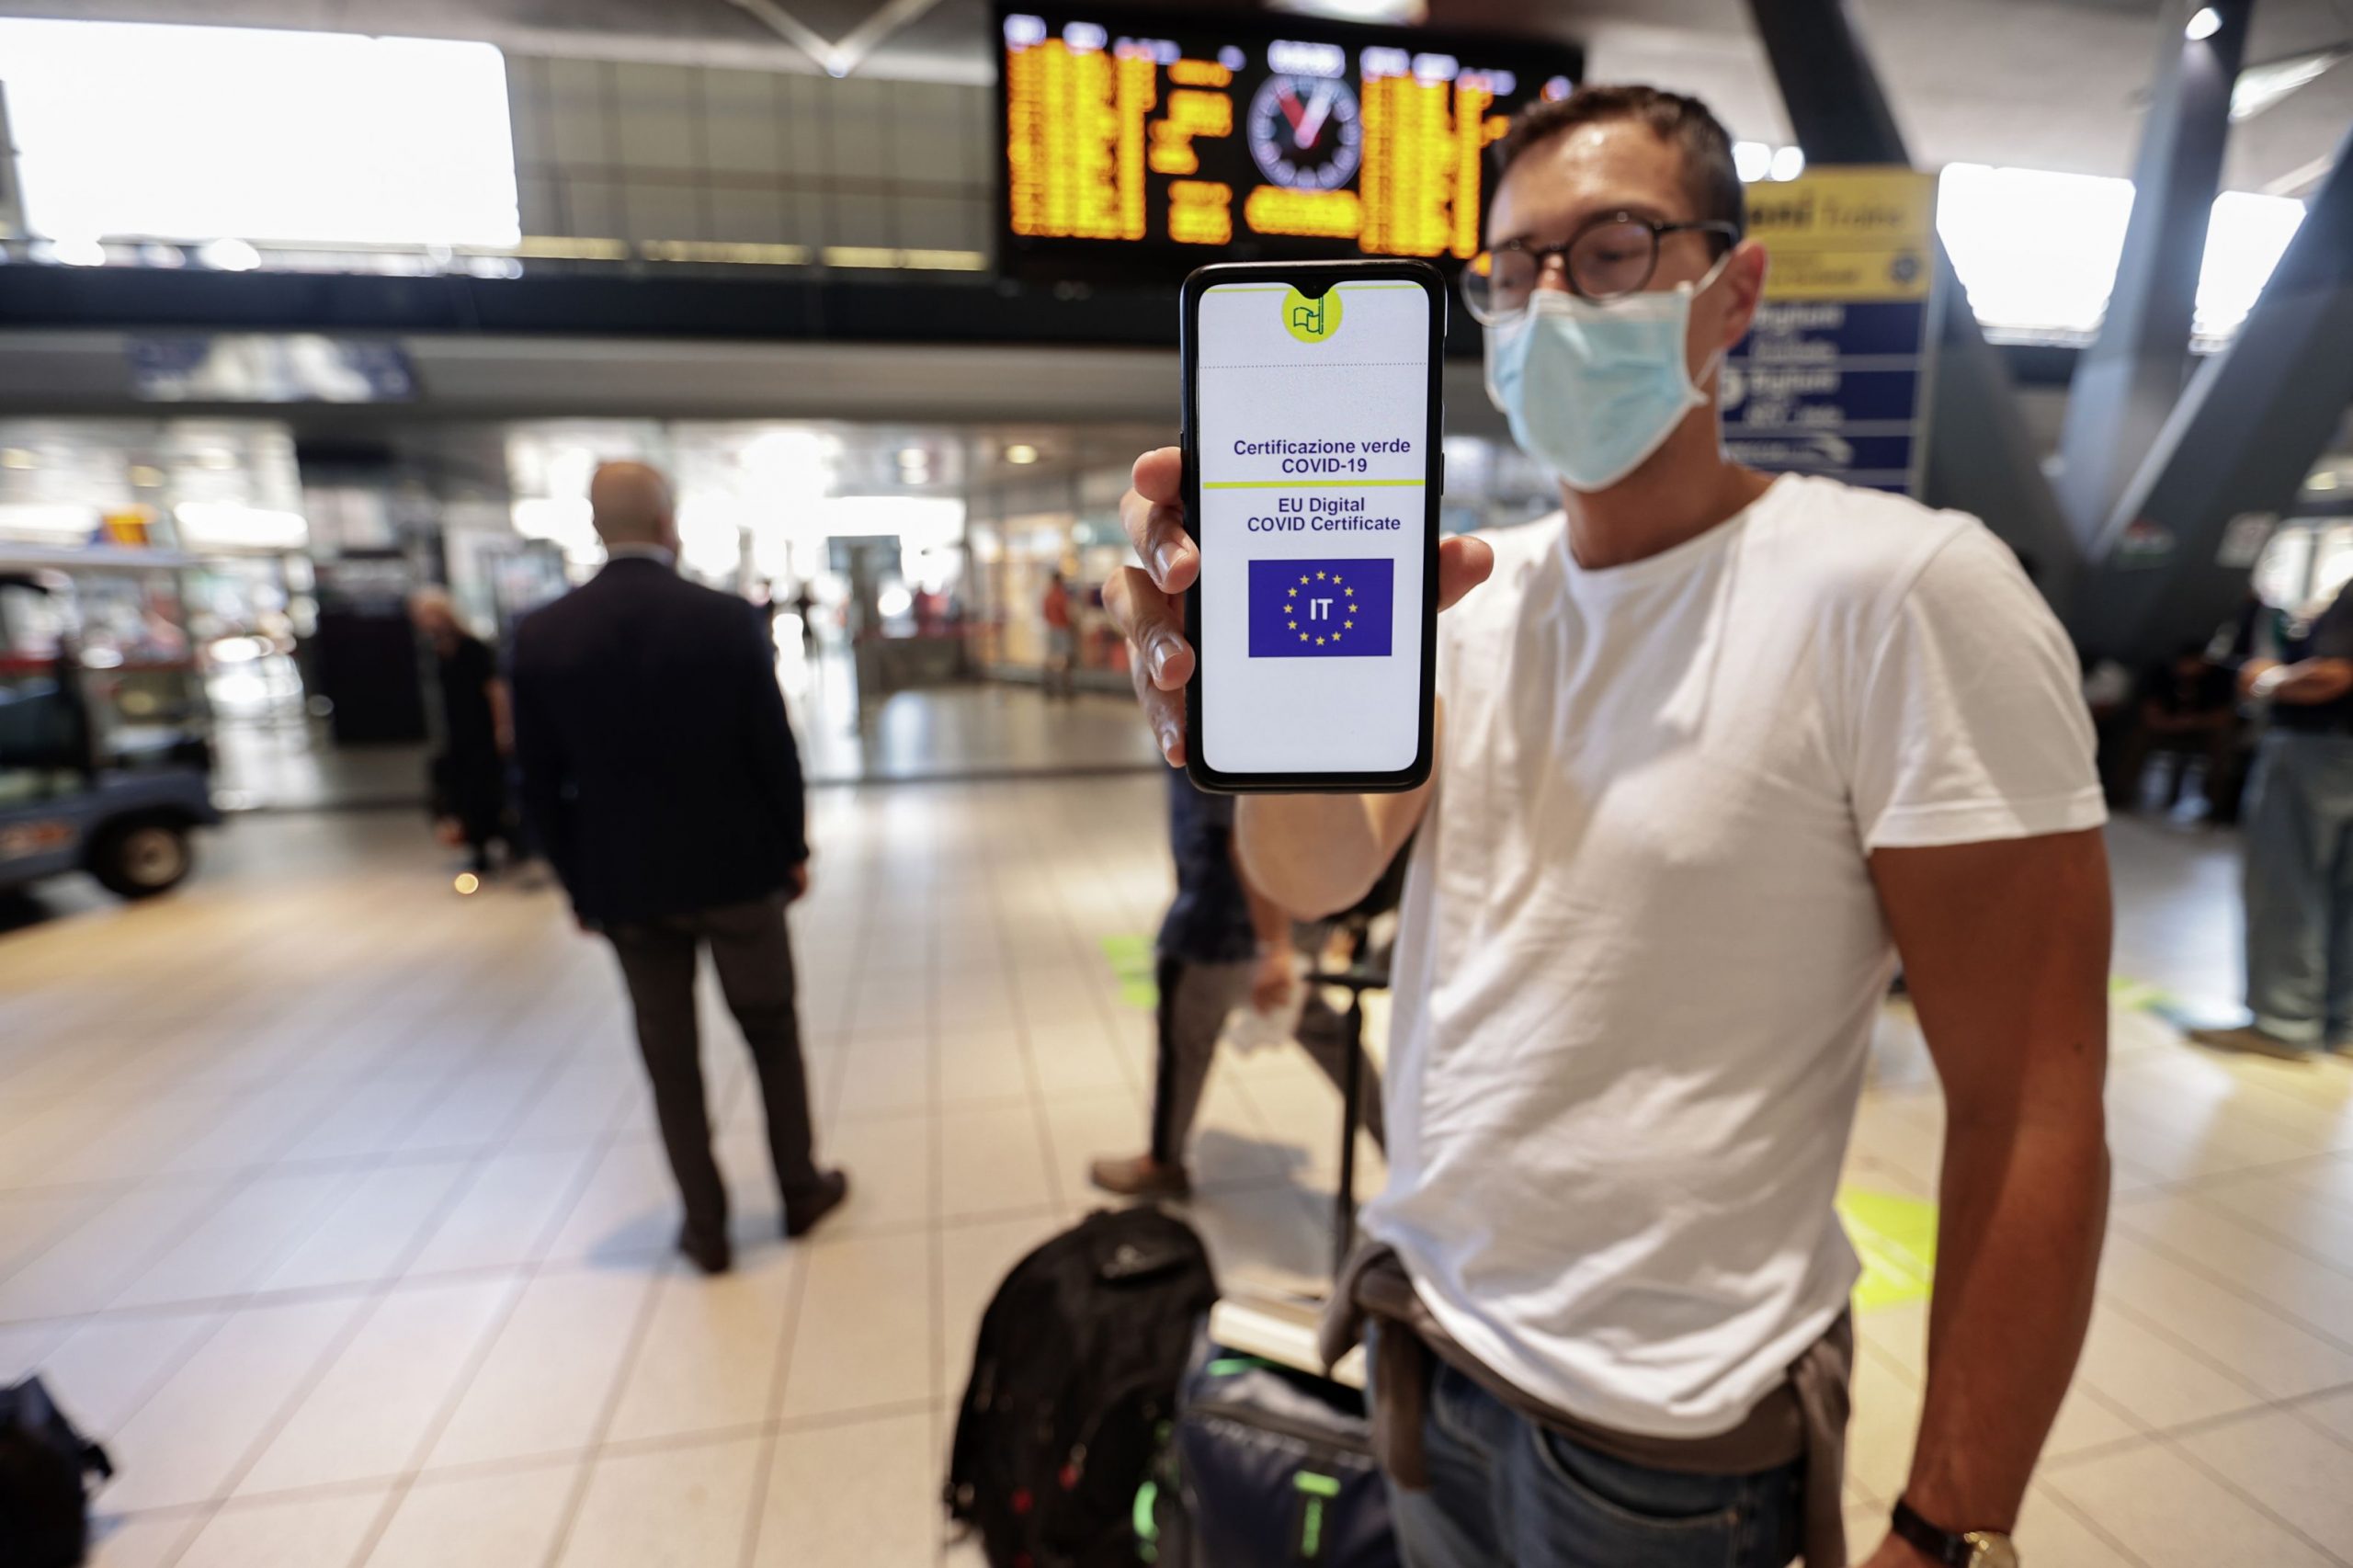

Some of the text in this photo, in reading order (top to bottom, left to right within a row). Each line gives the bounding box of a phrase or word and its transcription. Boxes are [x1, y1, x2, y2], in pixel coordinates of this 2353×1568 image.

[1233, 437, 1411, 456] Certificazione verde
[1281, 458, 1368, 474] COVID-19
[1279, 496, 1365, 517] EU Digital
[1247, 516, 1401, 532] COVID Certificate
[1310, 597, 1334, 621] IT
